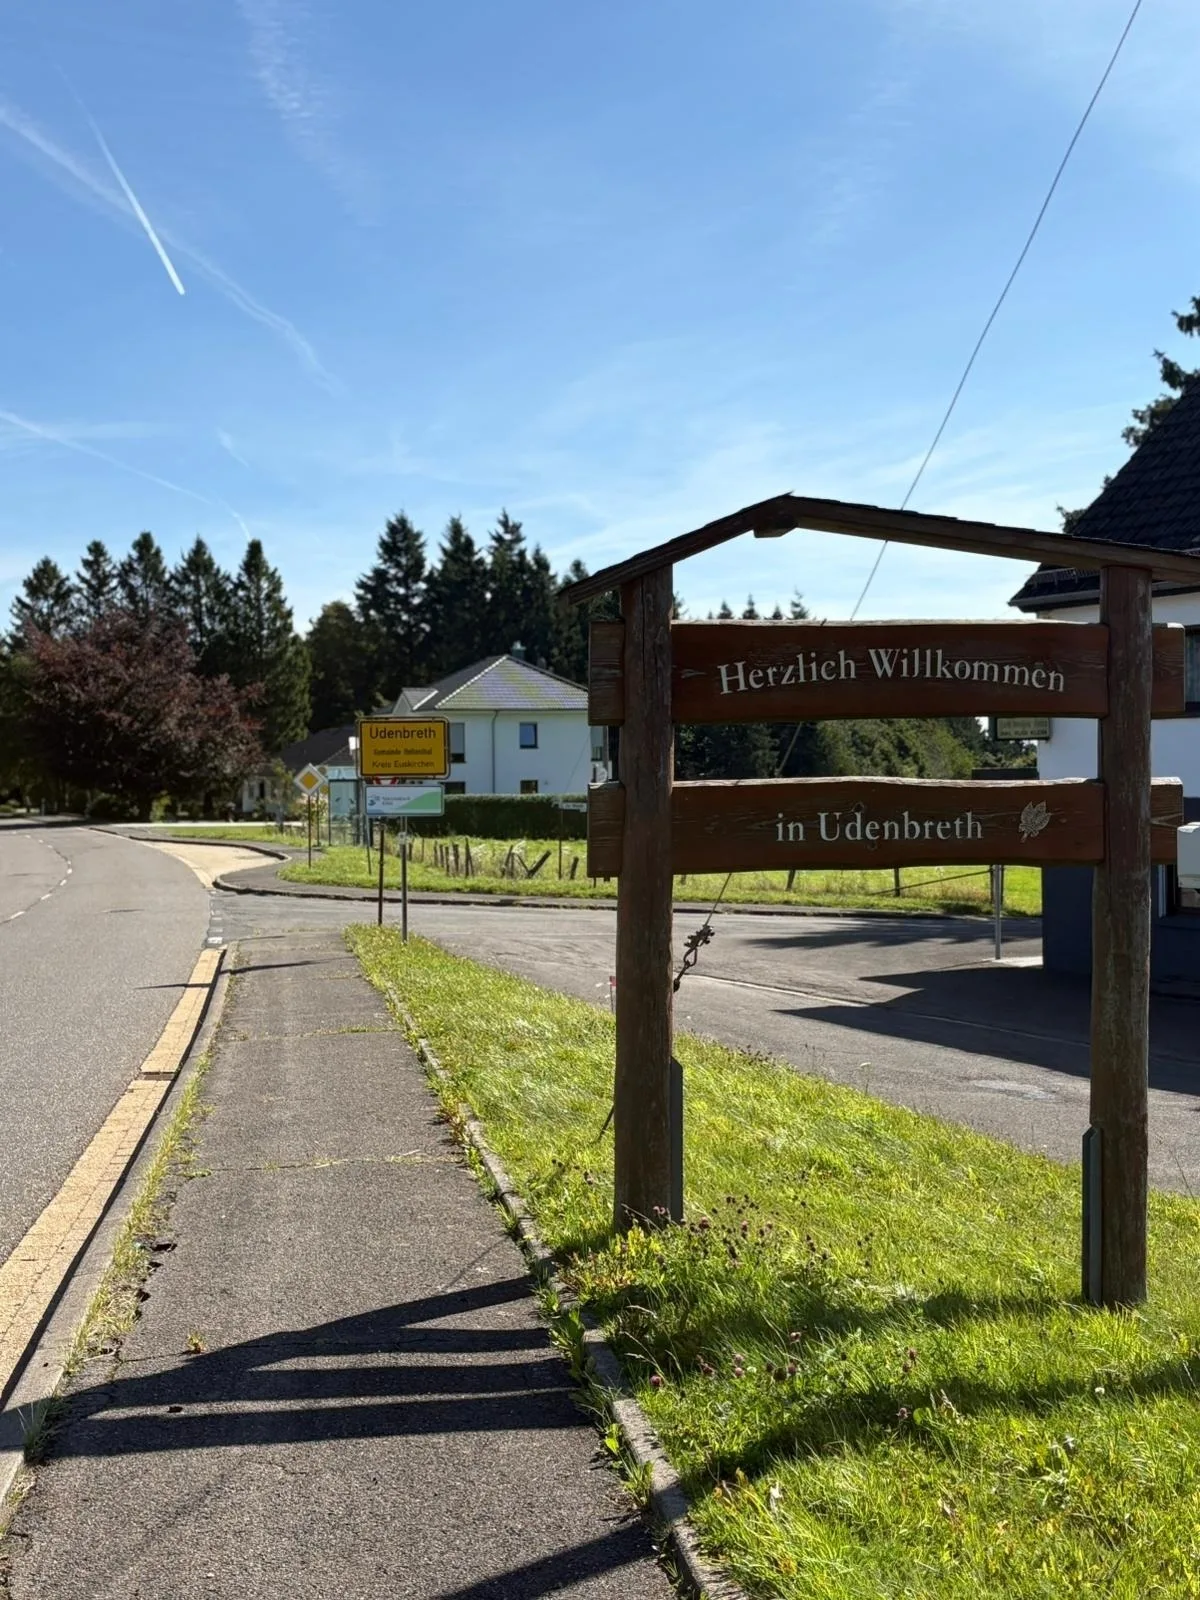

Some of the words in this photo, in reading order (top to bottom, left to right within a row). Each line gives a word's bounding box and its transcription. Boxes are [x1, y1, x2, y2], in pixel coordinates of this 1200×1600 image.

[717, 650, 856, 695] Herzlich
[868, 648, 1066, 693] Willkommen
[369, 726, 436, 739] Udenbreth
[372, 760, 392, 768] Kreis
[776, 812, 806, 841] in
[817, 811, 984, 841] Udenbreth
